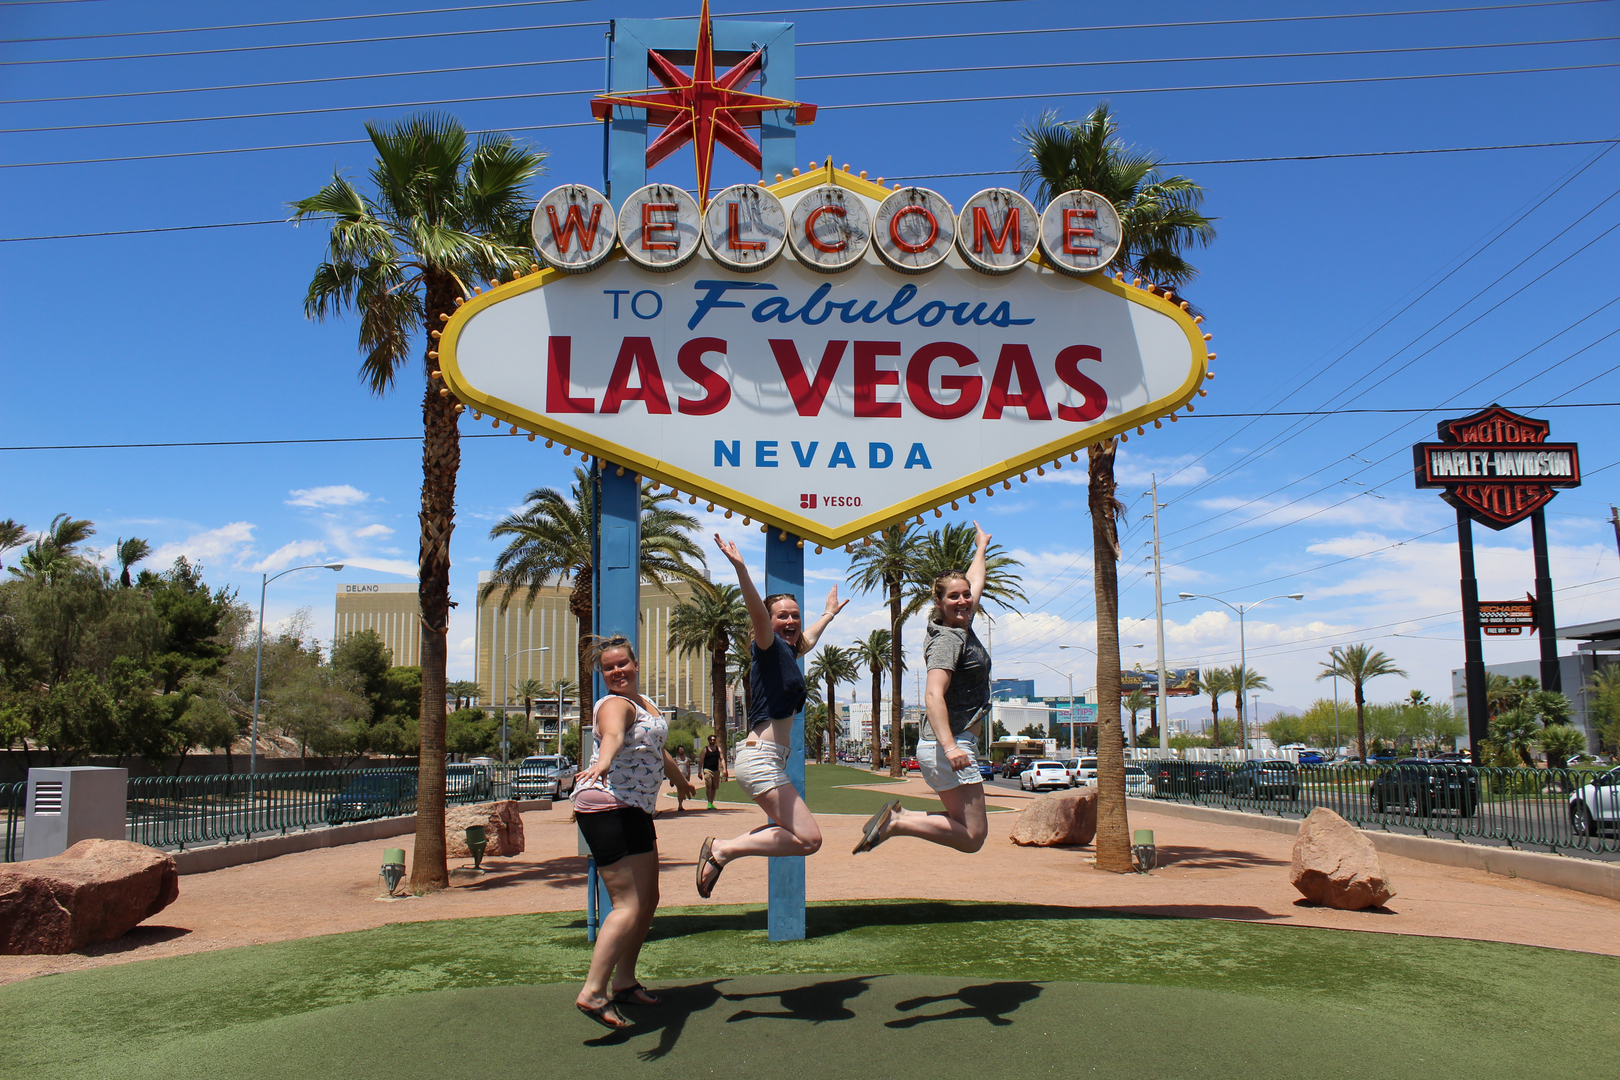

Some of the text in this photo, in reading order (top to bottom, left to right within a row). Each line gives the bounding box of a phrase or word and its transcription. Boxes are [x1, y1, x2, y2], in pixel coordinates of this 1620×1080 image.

[545, 202, 1099, 257] WELCOME
[603, 279, 1036, 331] TO Fabulous
[545, 335, 1109, 423] LAS VEGAS
[1462, 415, 1537, 443] MOTOR
[713, 439, 933, 470] NEVADA
[1431, 451, 1572, 477] HARLEY-DAVIDSON
[823, 496, 861, 507] YESCO
[1466, 484, 1541, 517] CYCLES
[345, 584, 379, 592] DELANO
[1479, 605, 1532, 613] RECHARGE
[1076, 708, 1094, 716] TIPS
